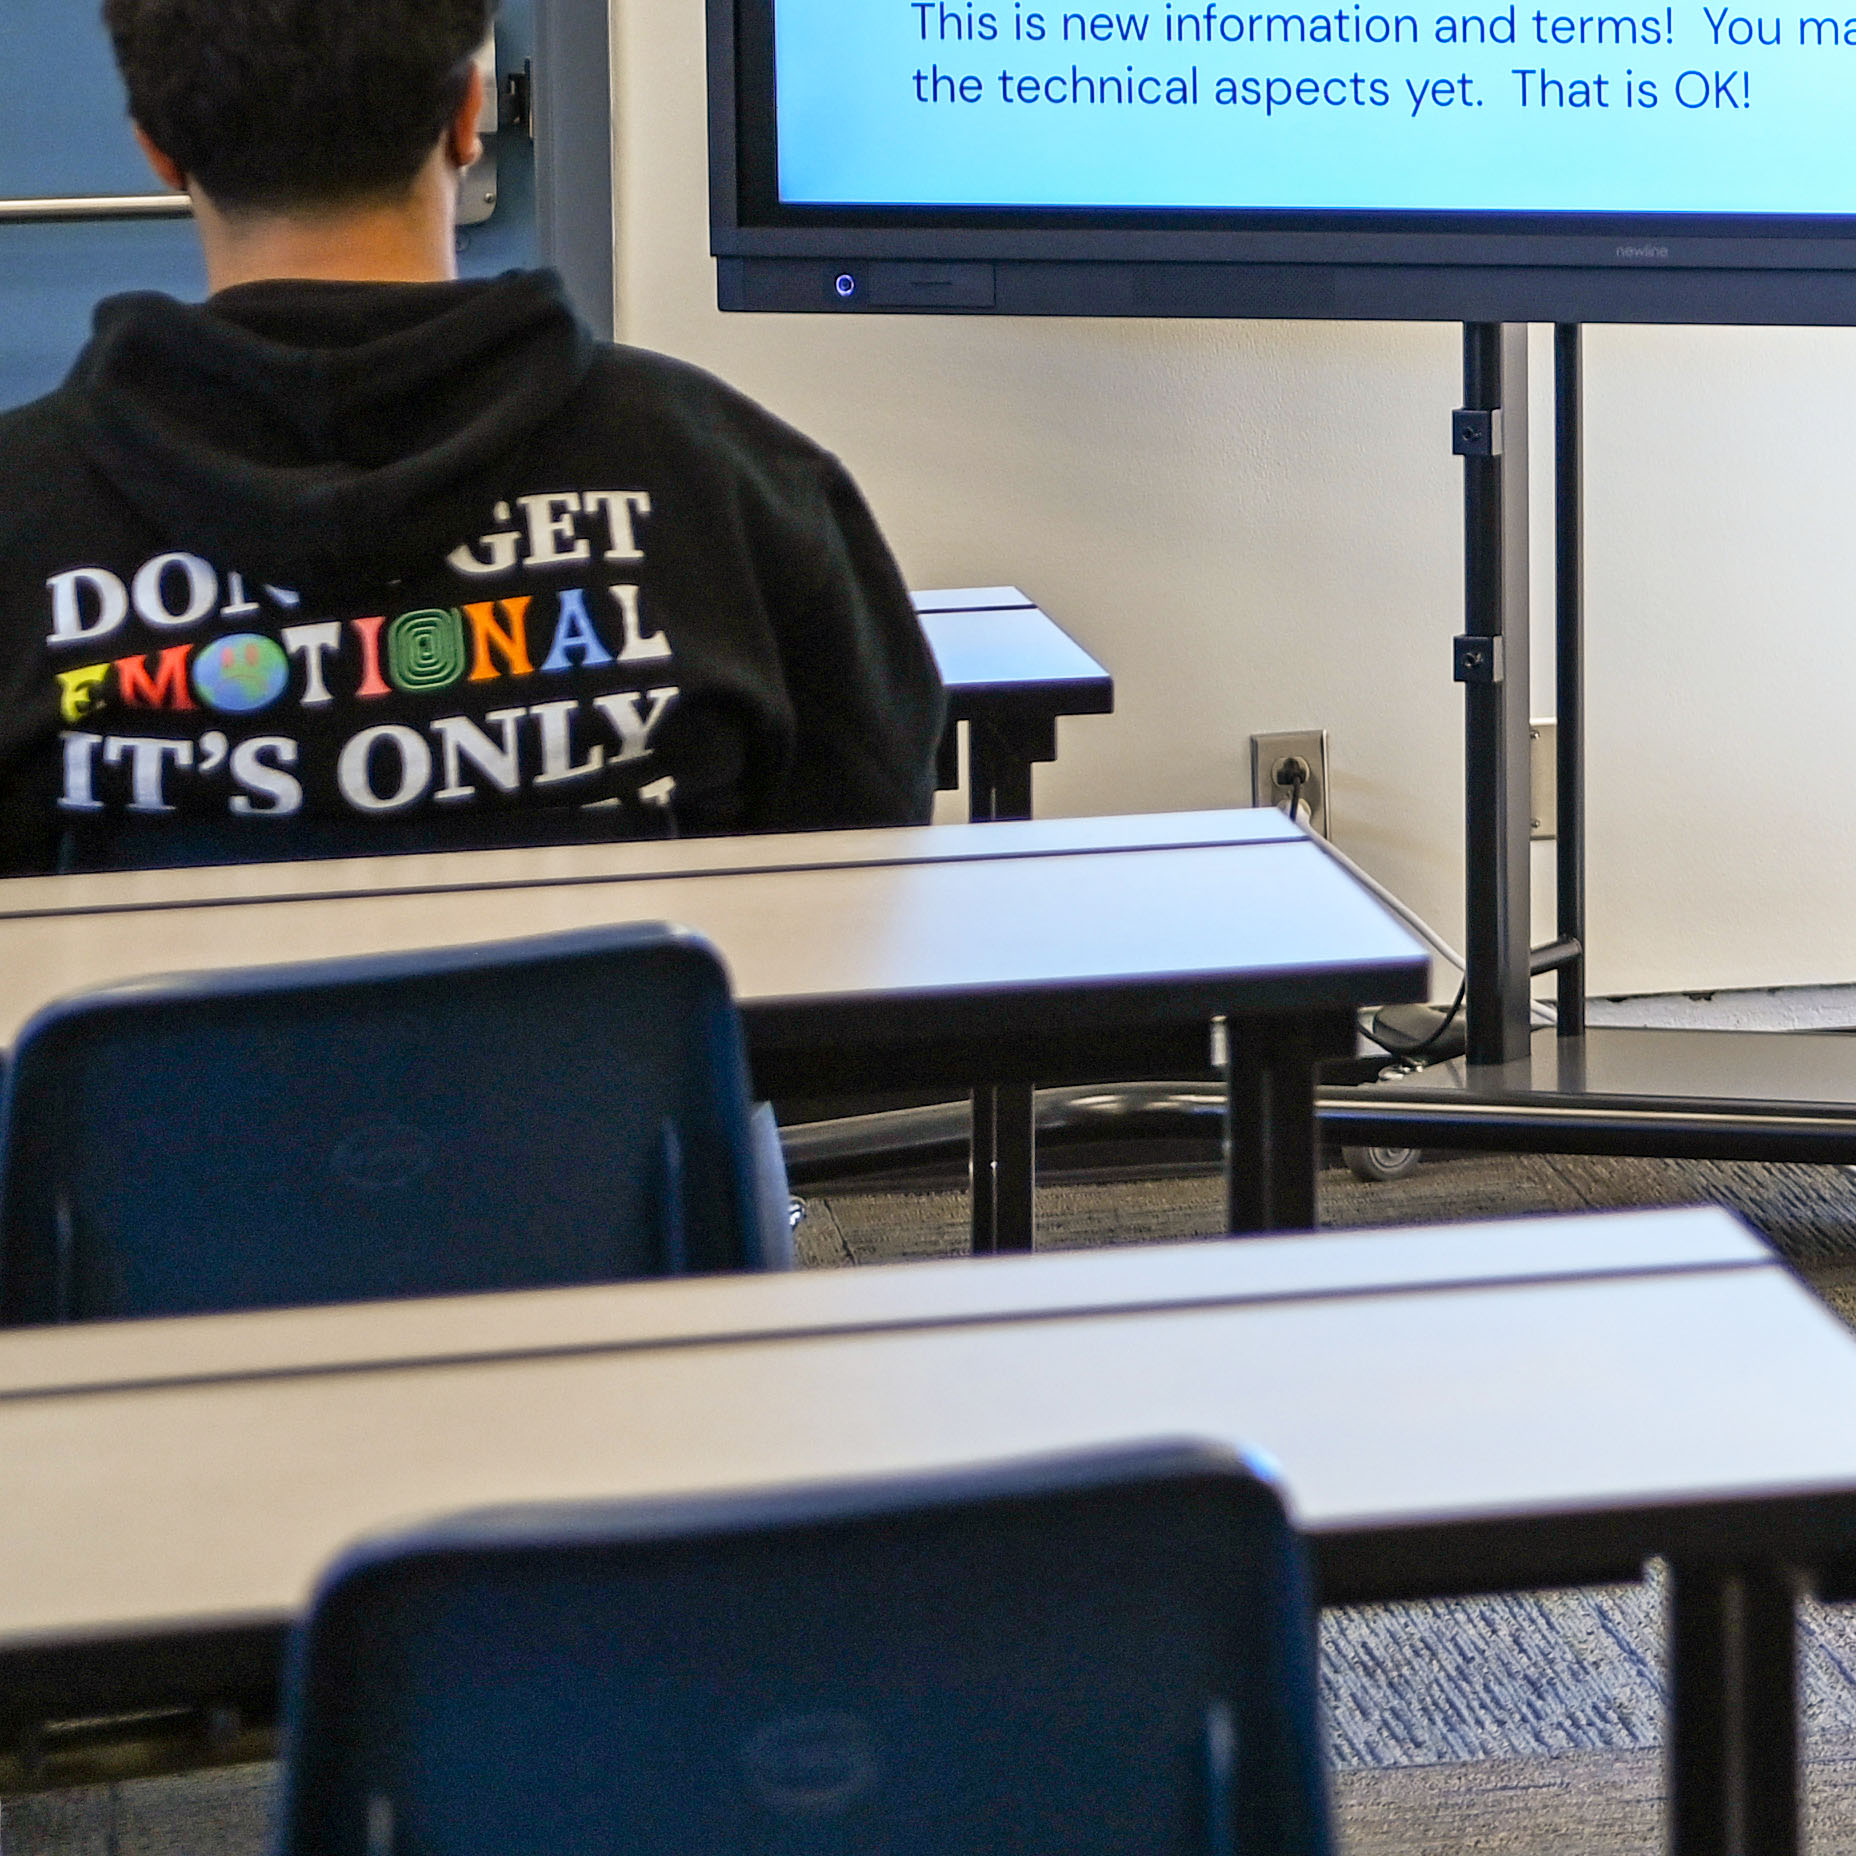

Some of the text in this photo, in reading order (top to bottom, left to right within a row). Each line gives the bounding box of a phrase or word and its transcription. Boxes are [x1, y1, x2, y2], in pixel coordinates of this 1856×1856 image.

[910, 0, 998, 41] This
[1014, 1, 1046, 42] is
[1063, 13, 1150, 42] new
[1165, 2, 1418, 44] information
[1434, 3, 1516, 44] and
[1531, 6, 1673, 45] terms!
[1702, 6, 1781, 46] You
[911, 63, 1750, 118] the technical aspects yet. That is OK!
[1616, 245, 1669, 257] newline
[447, 490, 652, 574] GET
[56, 686, 680, 815] IT'S ONLY
